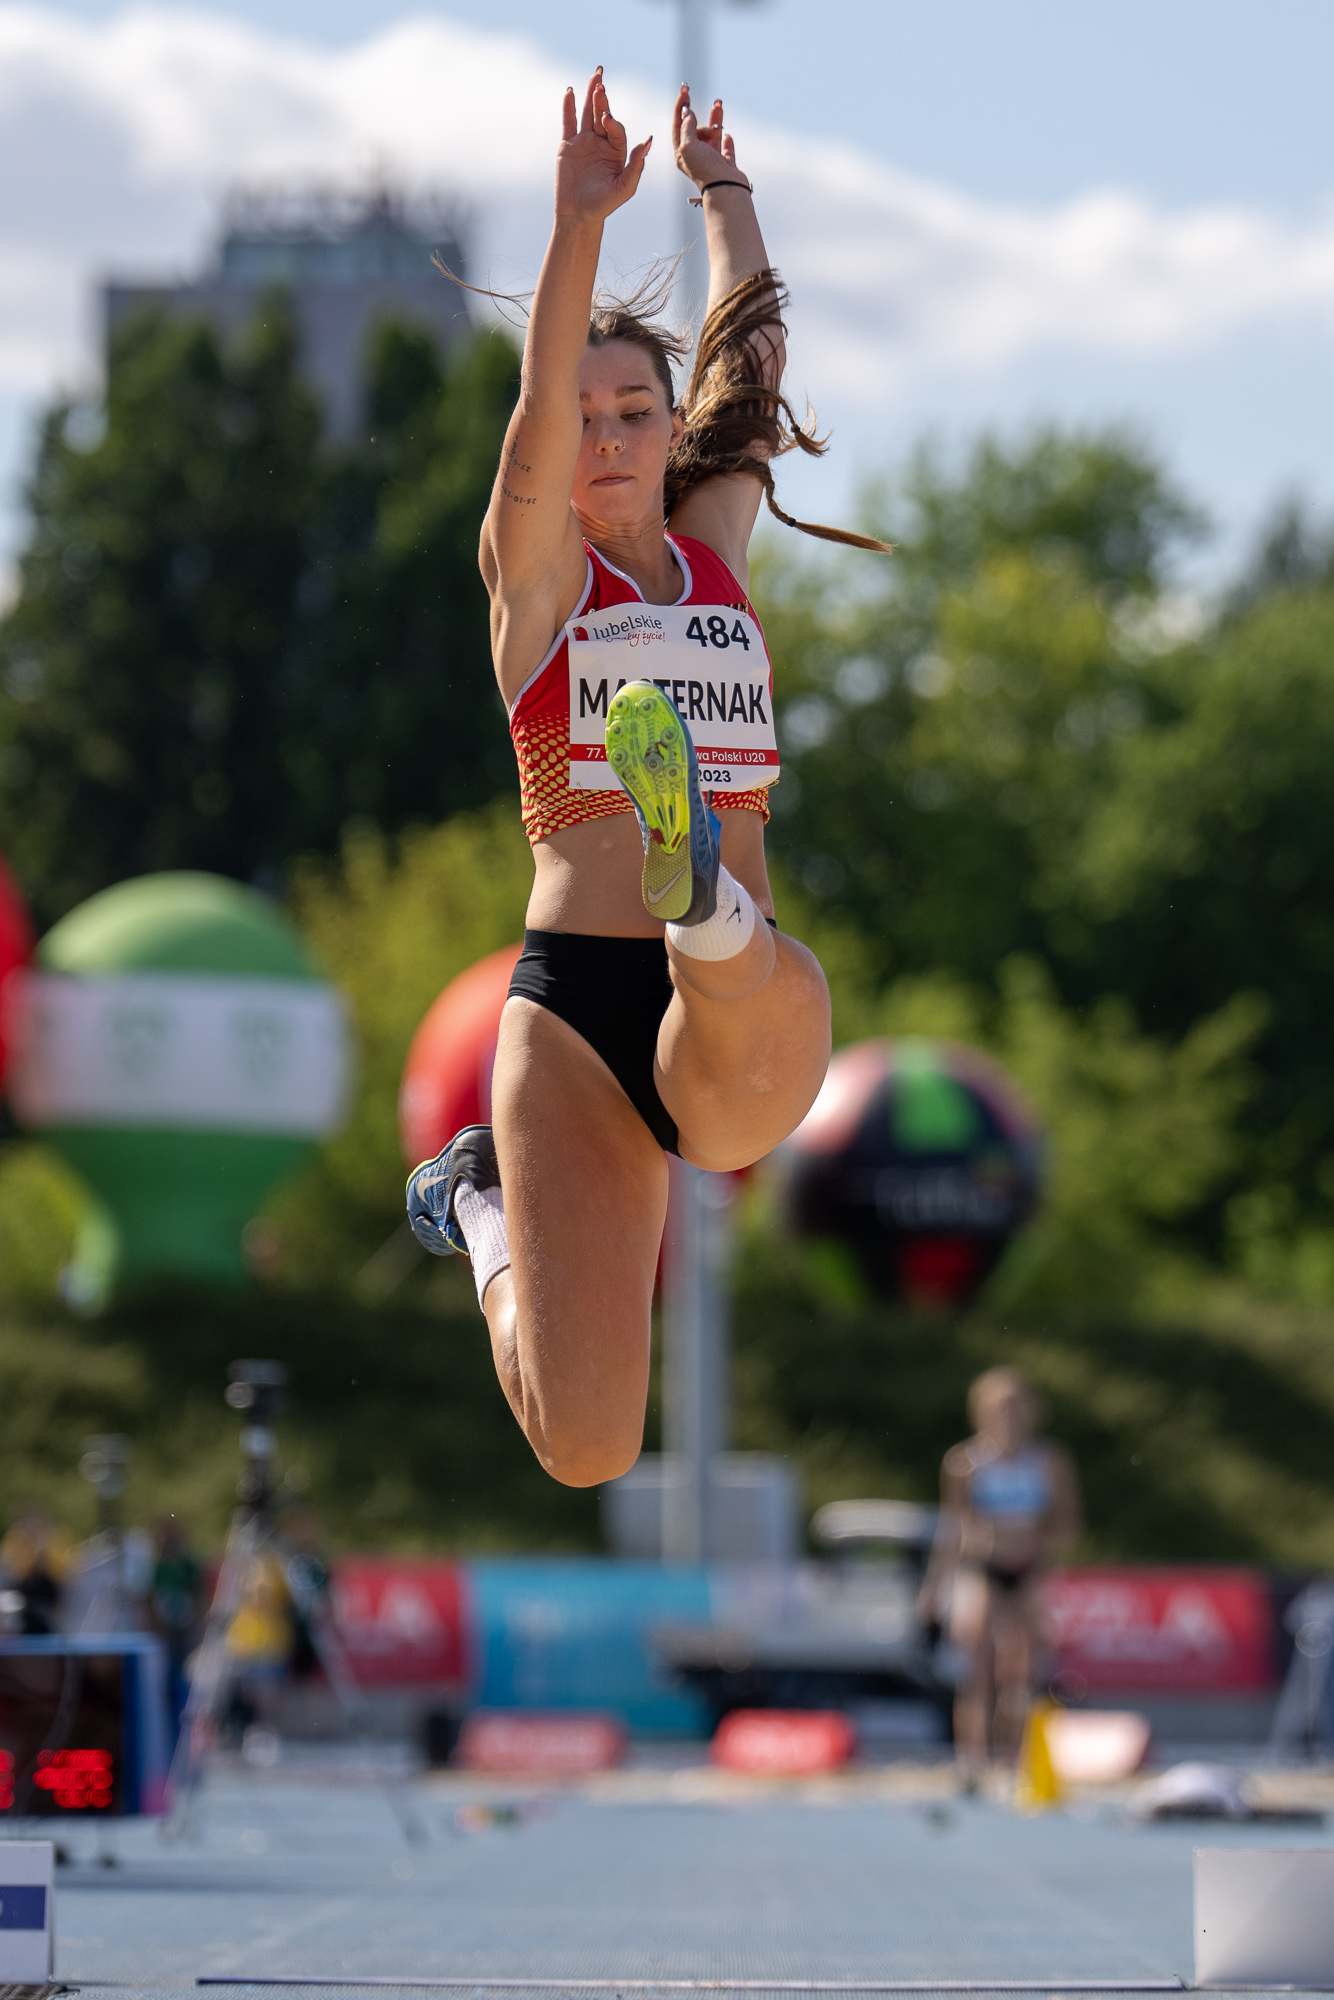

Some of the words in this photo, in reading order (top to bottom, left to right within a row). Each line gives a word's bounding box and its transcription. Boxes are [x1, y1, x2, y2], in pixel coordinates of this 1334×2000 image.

[592, 614, 663, 640] lubelskie
[685, 615, 750, 651] 484
[579, 678, 768, 725] MTERNAK
[586, 747, 604, 759] 77.
[711, 750, 742, 763] Polski
[744, 752, 766, 763] U20
